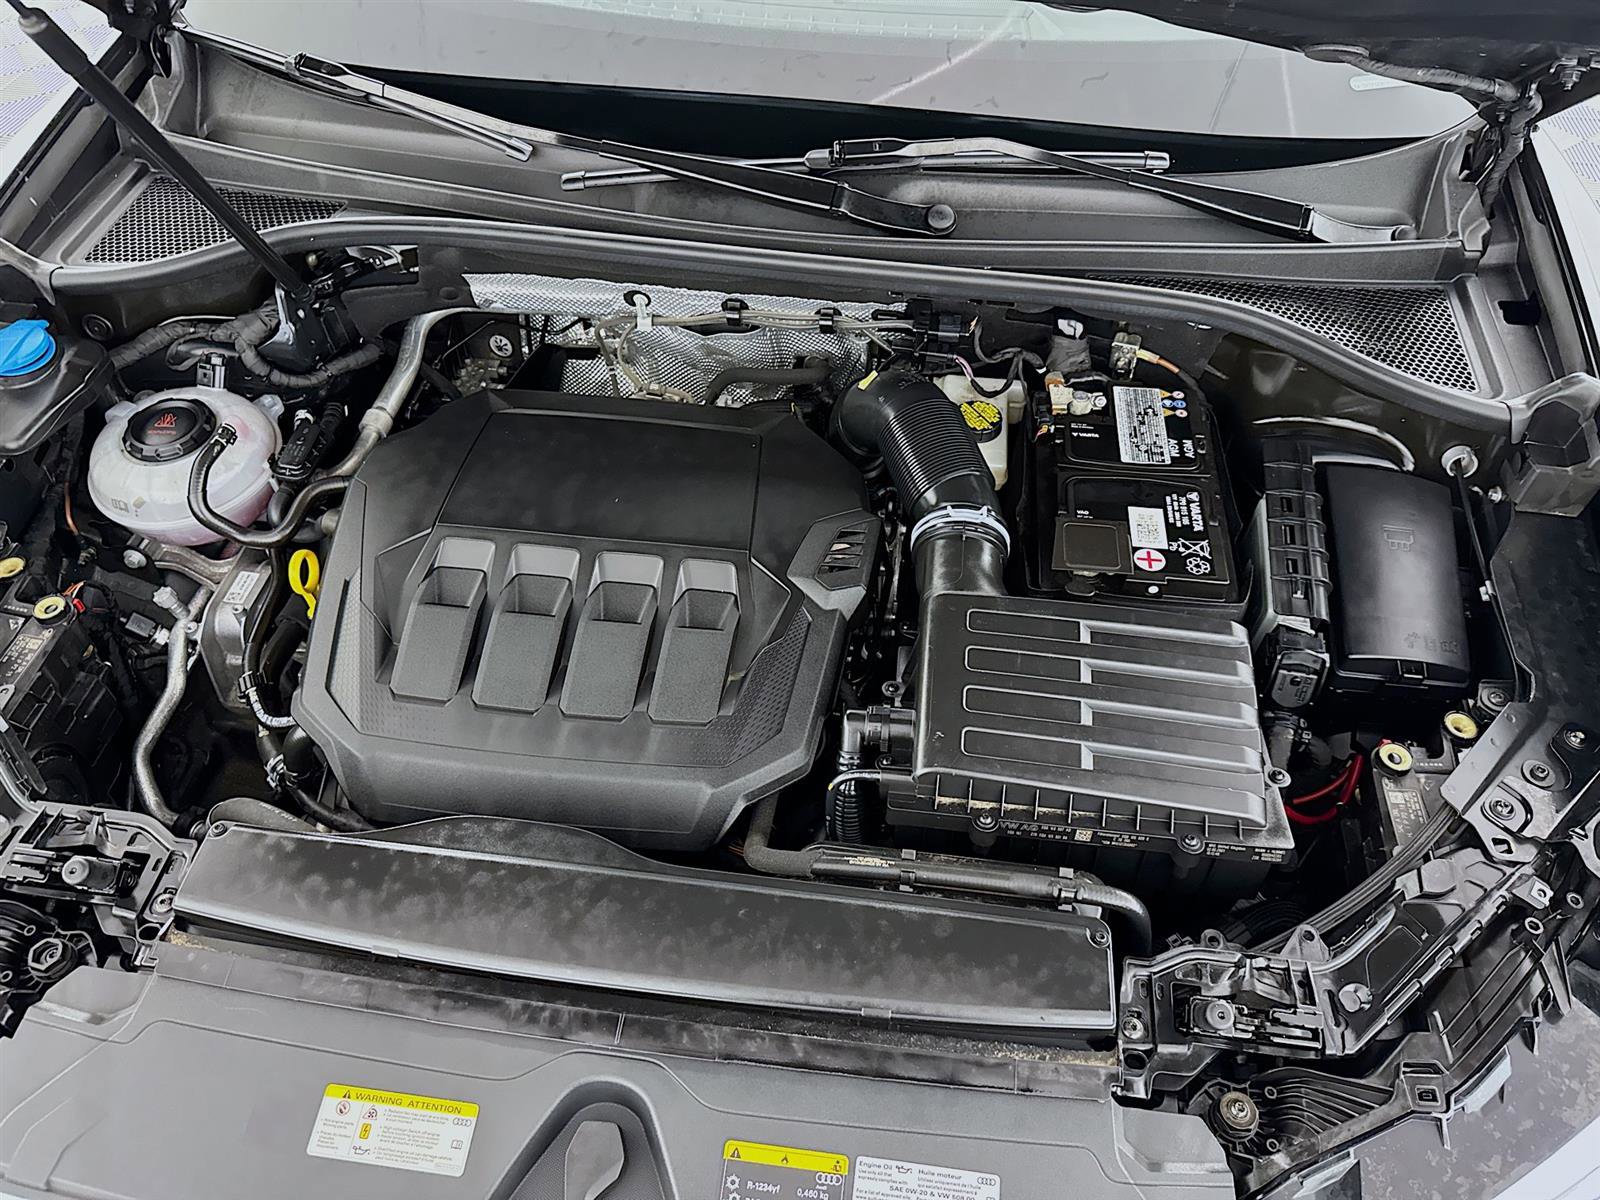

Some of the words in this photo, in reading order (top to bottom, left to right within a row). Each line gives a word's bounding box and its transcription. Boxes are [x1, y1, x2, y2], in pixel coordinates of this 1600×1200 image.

[1168, 439, 1180, 457] AGM
[1182, 440, 1195, 458] AGM
[1190, 502, 1204, 531] VARTA
[355, 1092, 403, 1106] WARNING
[407, 1100, 462, 1114] ATTENTION
[859, 1161, 881, 1169] Engine
[937, 1172, 962, 1180] moteur
[746, 1180, 780, 1194] R-1234yf
[890, 1185, 904, 1193] SAE
